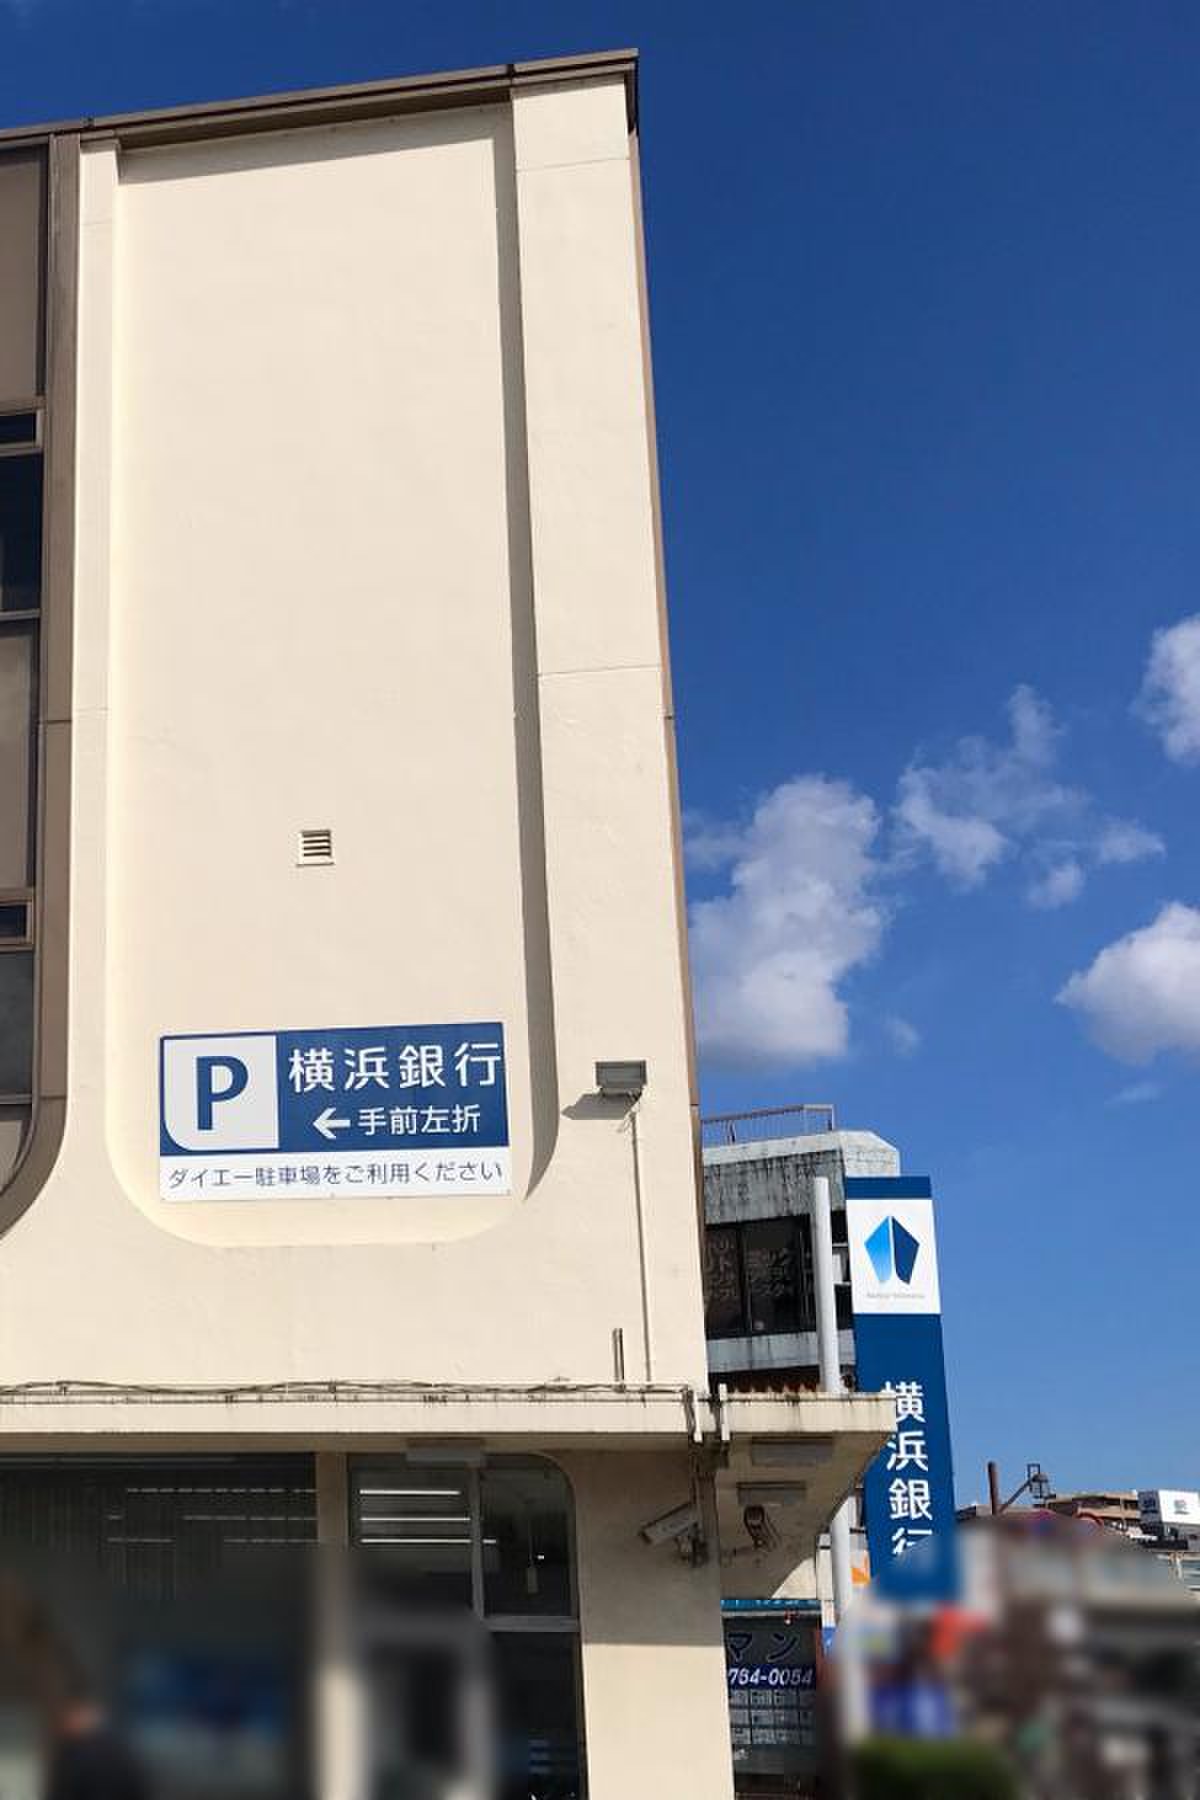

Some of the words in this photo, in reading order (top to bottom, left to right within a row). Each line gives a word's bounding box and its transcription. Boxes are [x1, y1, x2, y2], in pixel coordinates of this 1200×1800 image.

[288, 1042, 501, 1093] 横浜銀行
[196, 1055, 249, 1131] P
[358, 1104, 481, 1136] 手前左折
[168, 1161, 503, 1188] ダイエー駐車場をご利用ください
